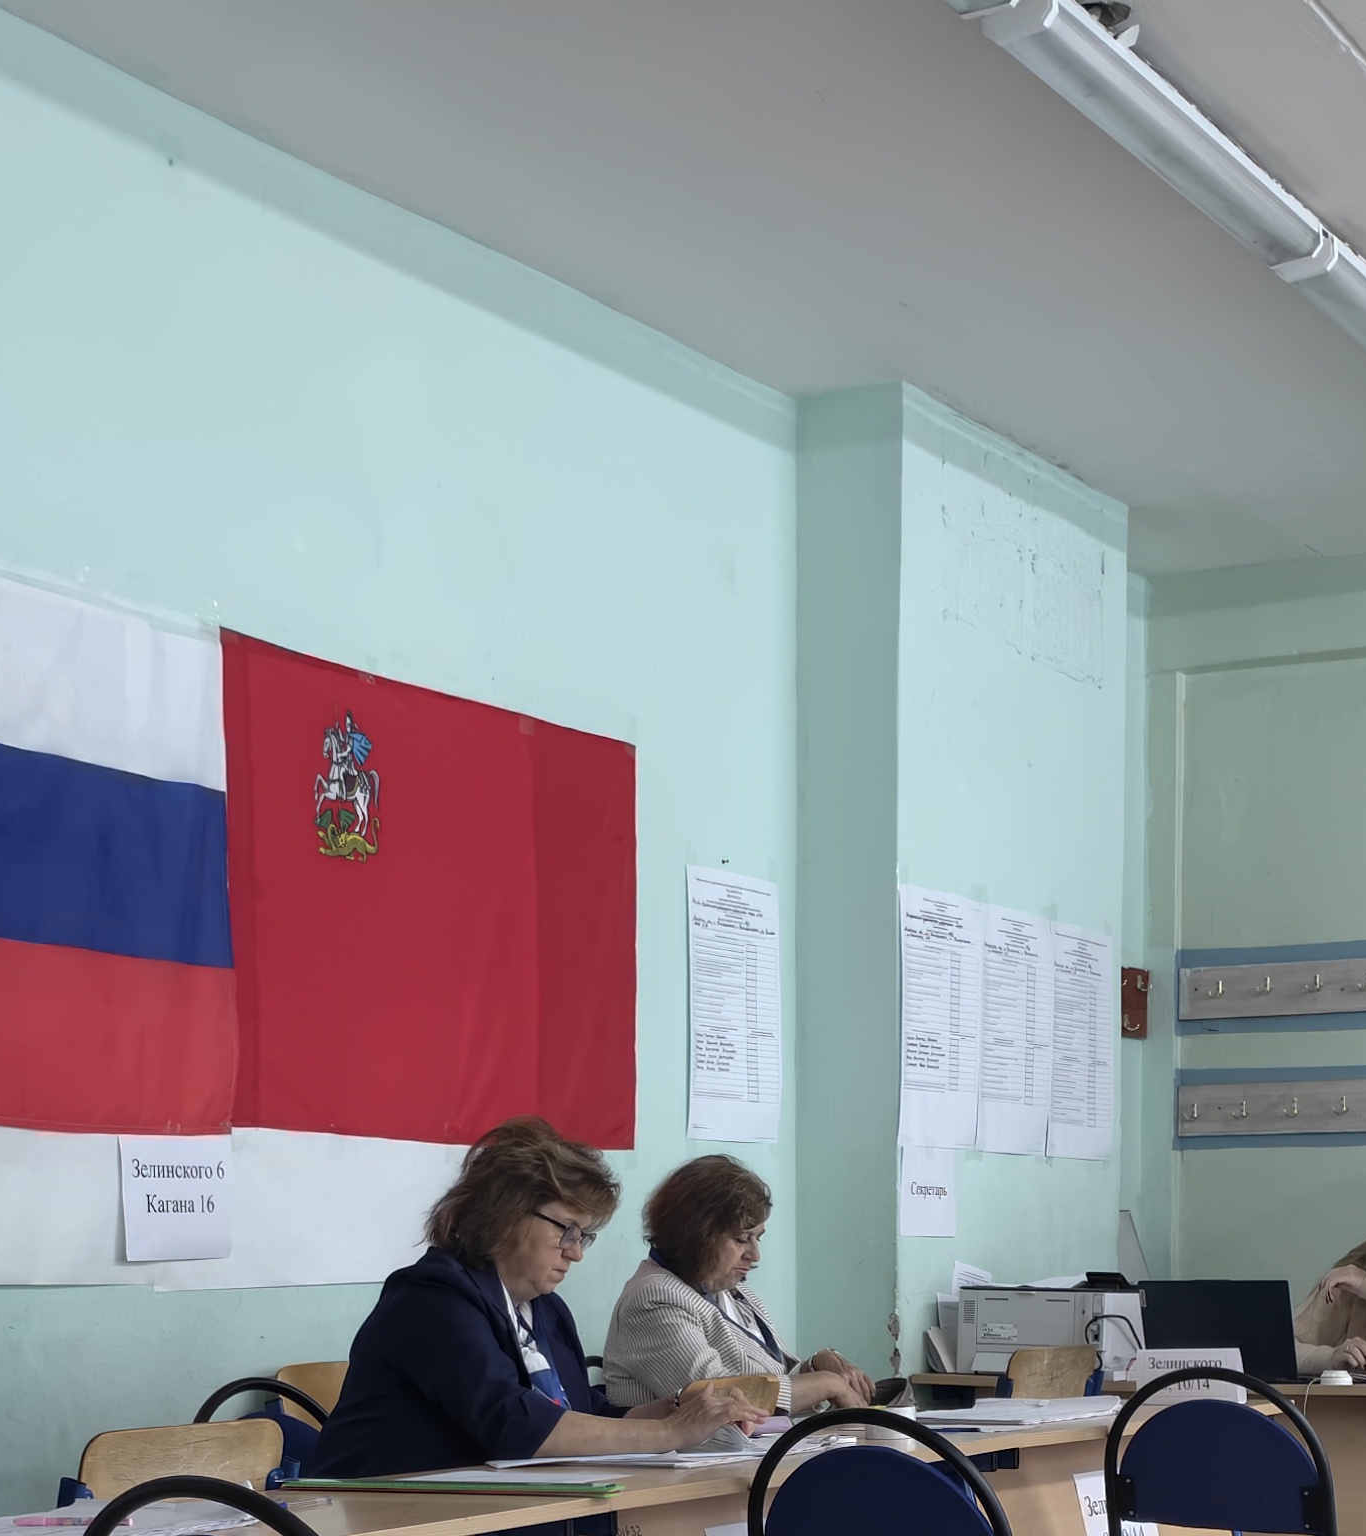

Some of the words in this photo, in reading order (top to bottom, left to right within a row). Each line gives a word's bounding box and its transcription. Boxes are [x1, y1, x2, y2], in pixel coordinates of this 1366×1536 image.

[132, 1158, 212, 1179] Зелинского
[217, 1161, 225, 1179] 6
[910, 1181, 948, 1200] Секретарь
[146, 1194, 195, 1214] Кагана
[200, 1194, 215, 1214] 16
